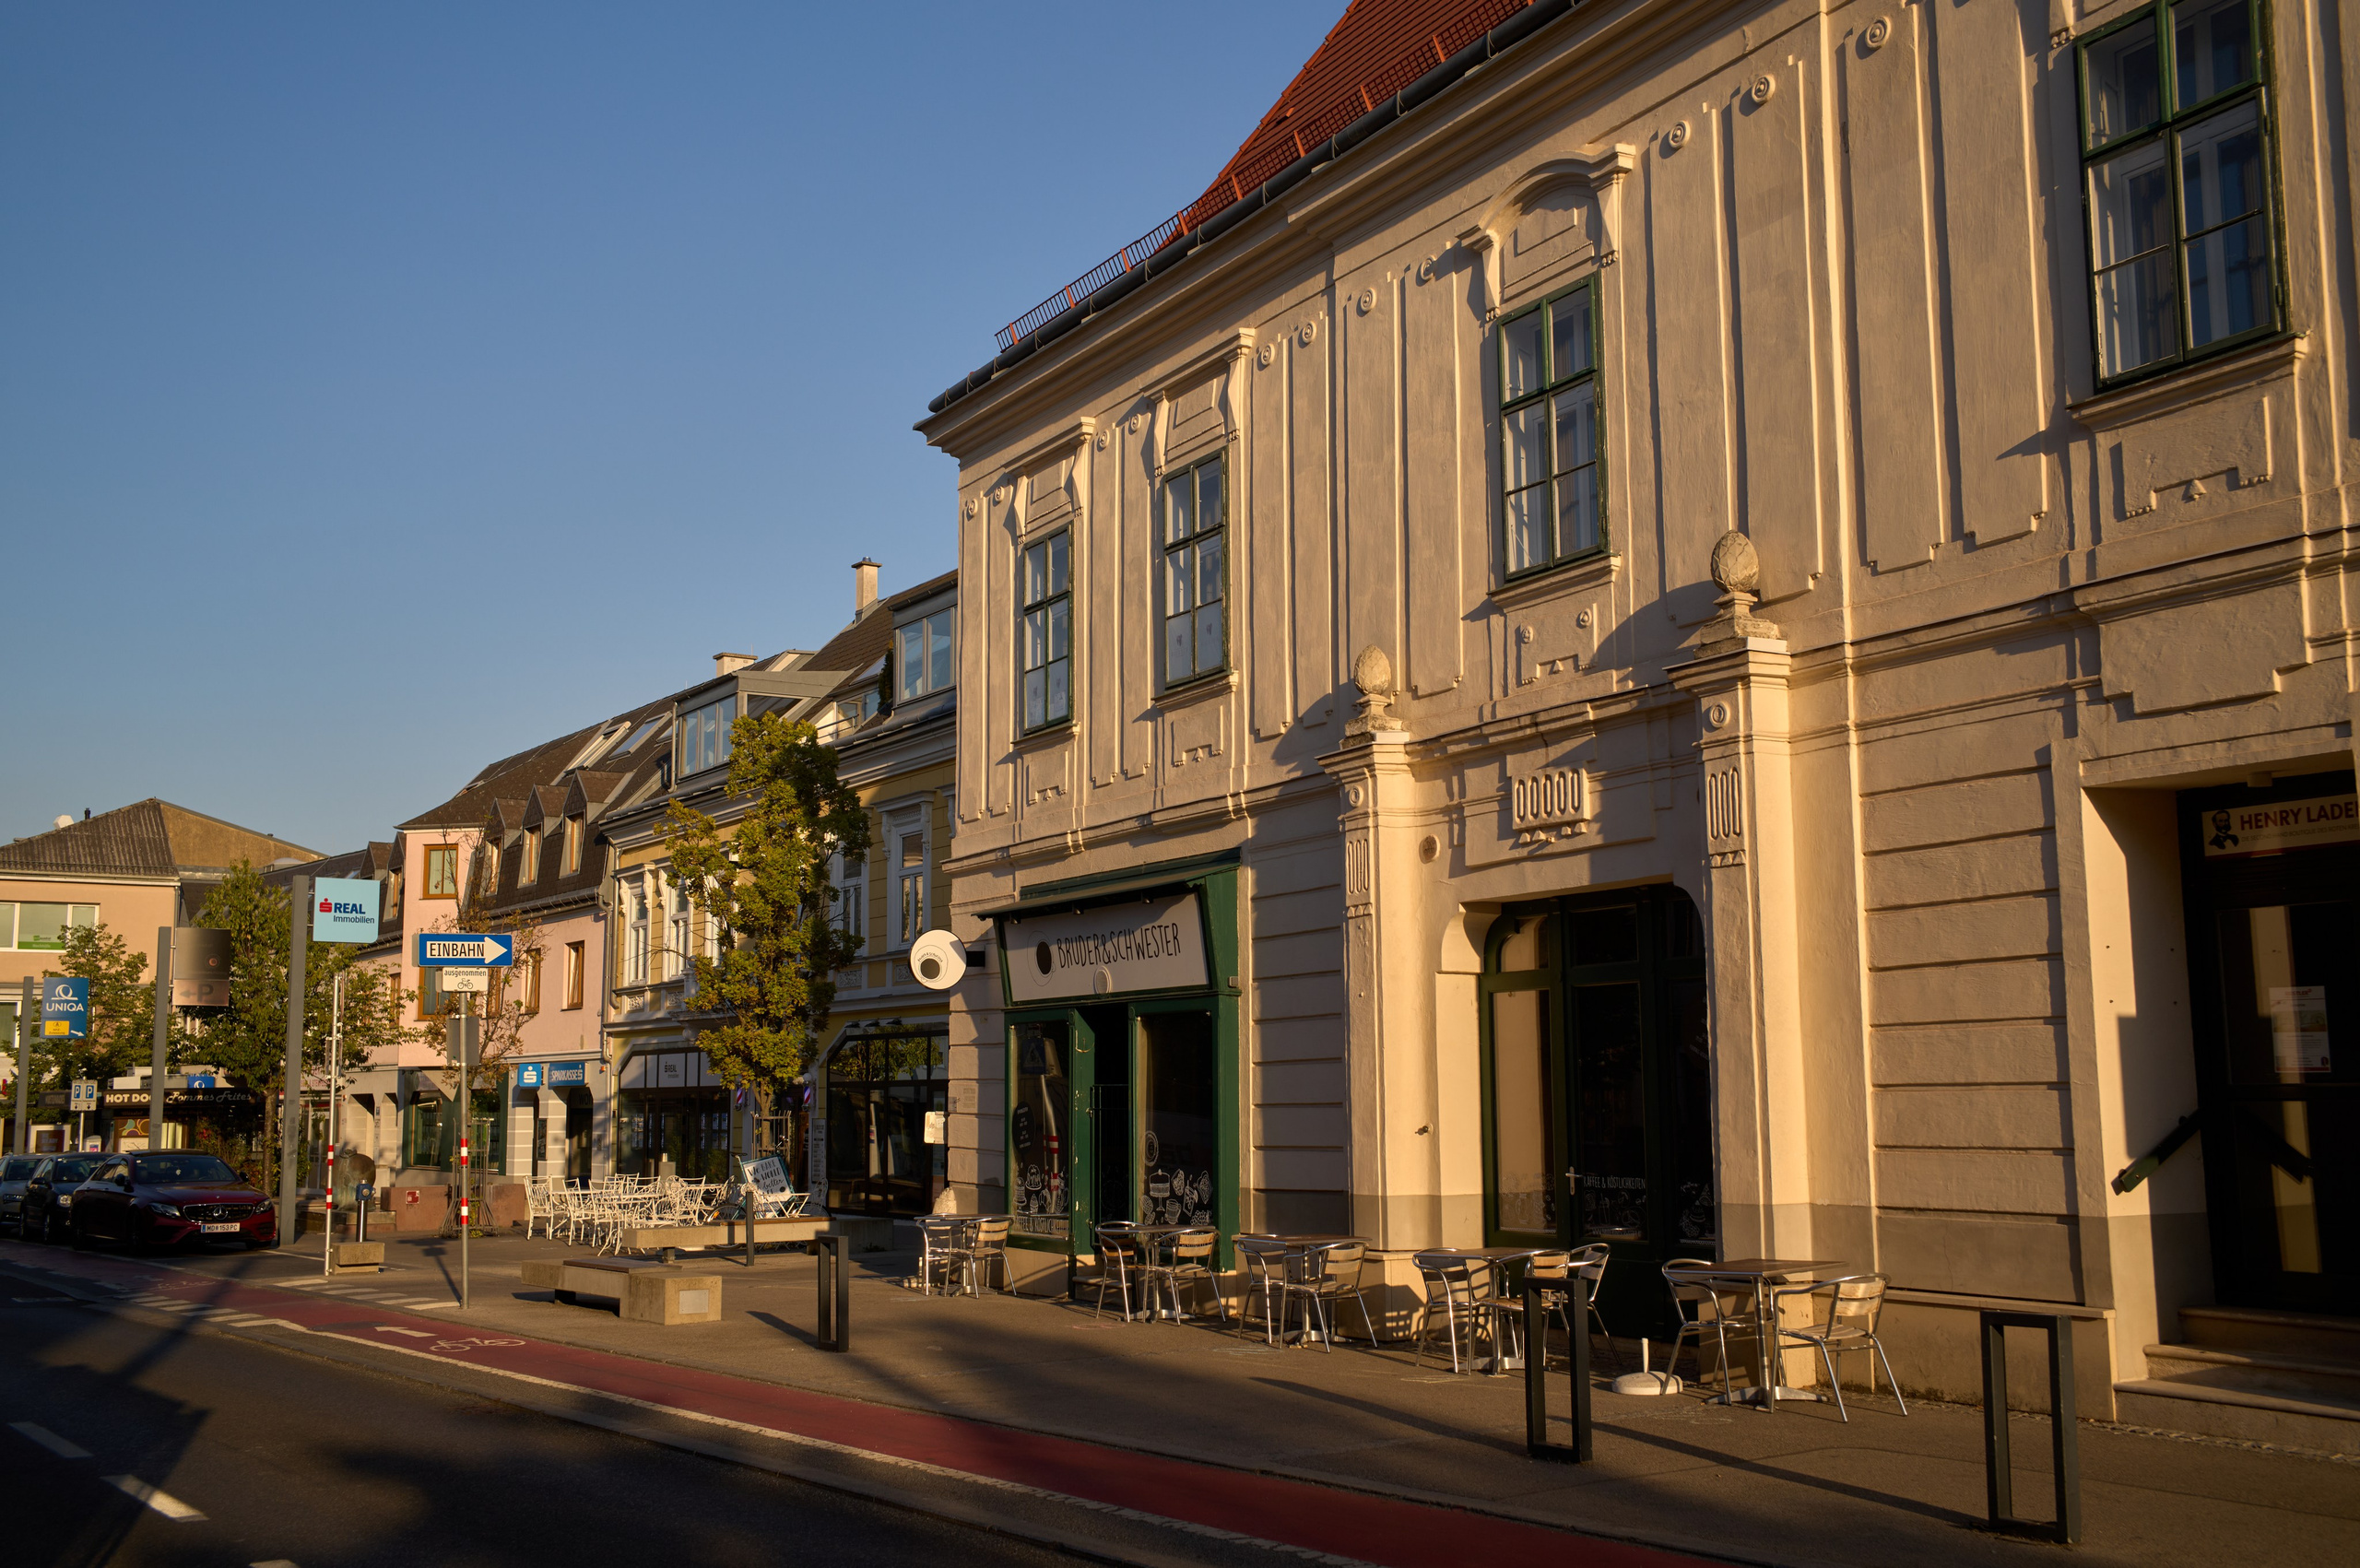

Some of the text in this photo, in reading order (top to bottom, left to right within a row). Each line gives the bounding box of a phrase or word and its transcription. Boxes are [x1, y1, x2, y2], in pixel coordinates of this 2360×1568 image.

[2240, 807, 2301, 831] HENRY
[334, 902, 366, 914] REAL
[333, 915, 375, 924] Immobilien
[430, 943, 484, 957] EINBAHN
[46, 1002, 84, 1012] UNIQA
[106, 1093, 130, 1103] HOT
[132, 1093, 152, 1103] DO
[166, 1091, 252, 1103] Pommes Frites
[1583, 1175, 1600, 1188] KAFFEE
